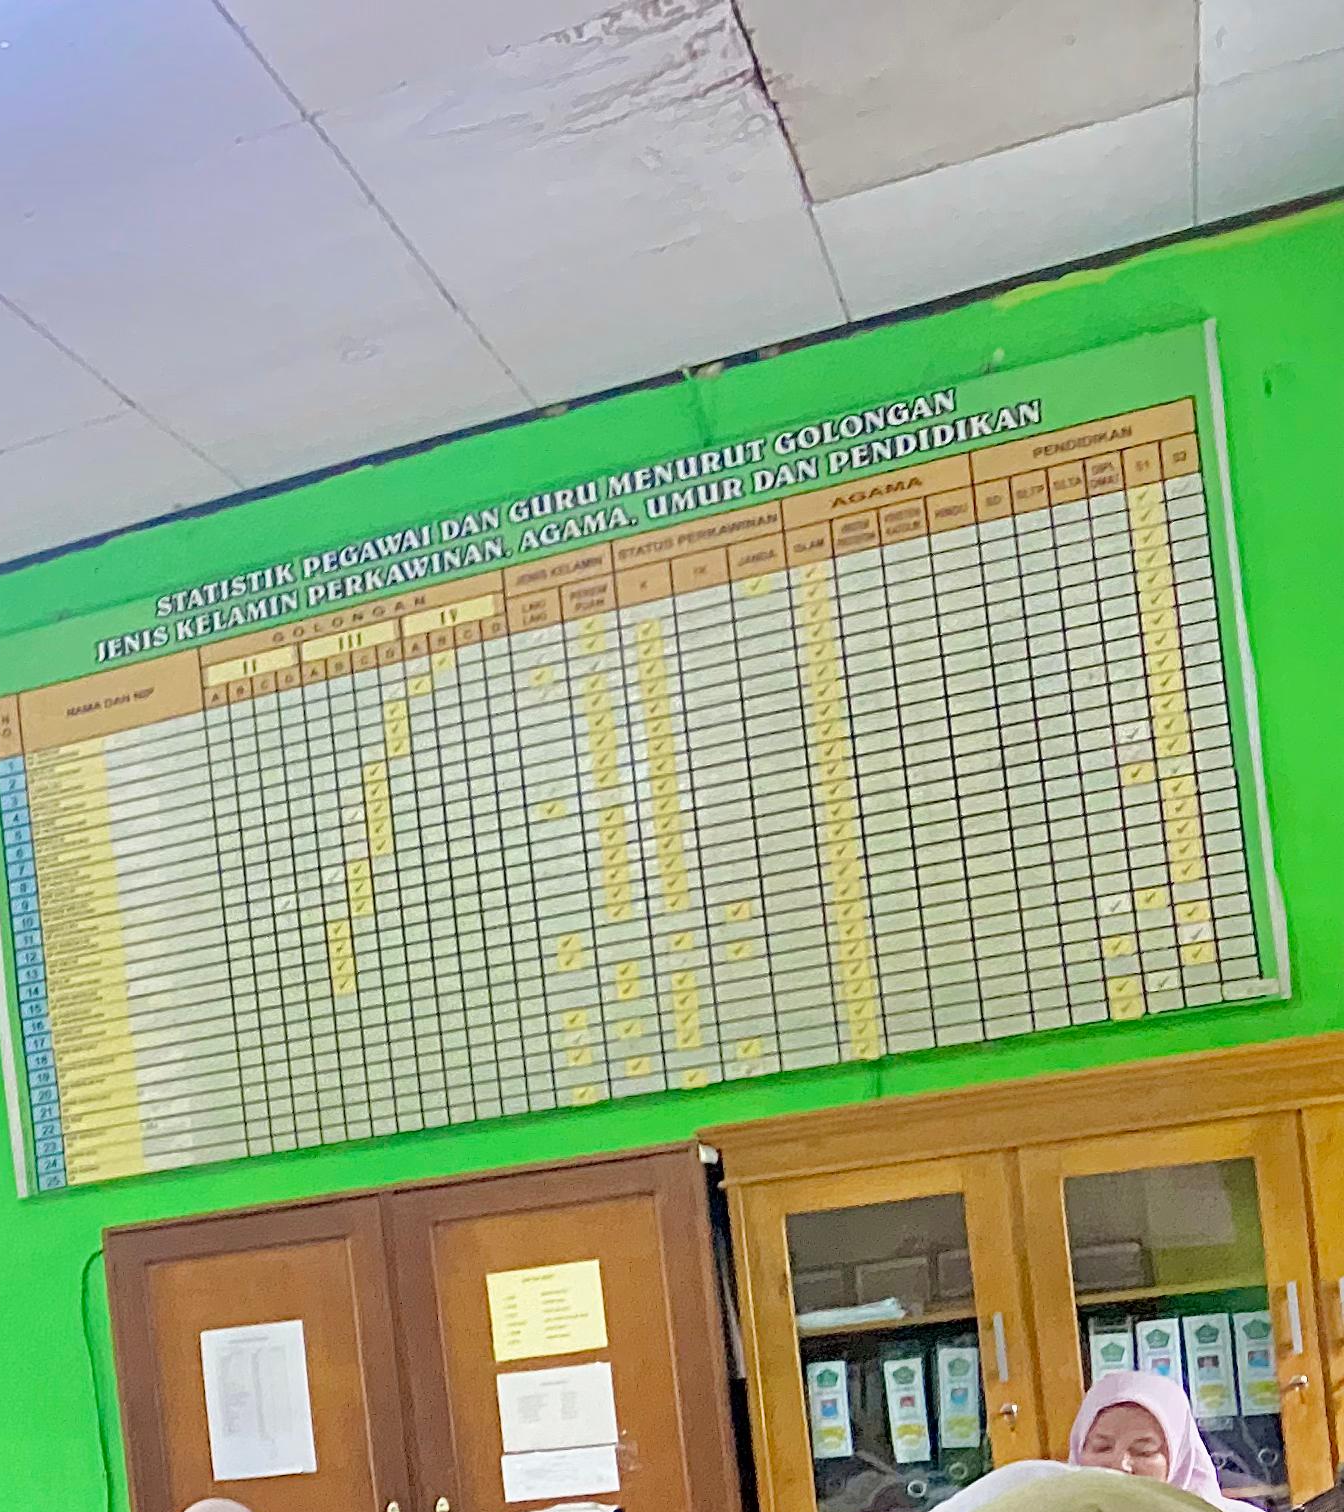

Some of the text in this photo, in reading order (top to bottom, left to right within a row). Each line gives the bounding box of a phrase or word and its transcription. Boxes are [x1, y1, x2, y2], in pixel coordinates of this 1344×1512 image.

[1033, 425, 1133, 459] PENDIDIKAN
[156, 387, 955, 618] STATISTIK PEGAWAI DAN GURU MENURUT GOLONGAN
[831, 476, 923, 508] AGAMA
[95, 626, 169, 663] JENIS
[174, 588, 298, 642] KELAMIN
[646, 476, 743, 519] UMUR
[753, 456, 818, 494] DAN
[827, 398, 1041, 475] PENDIDIKAN
[338, 631, 363, 651] III
[242, 658, 257, 675] II
